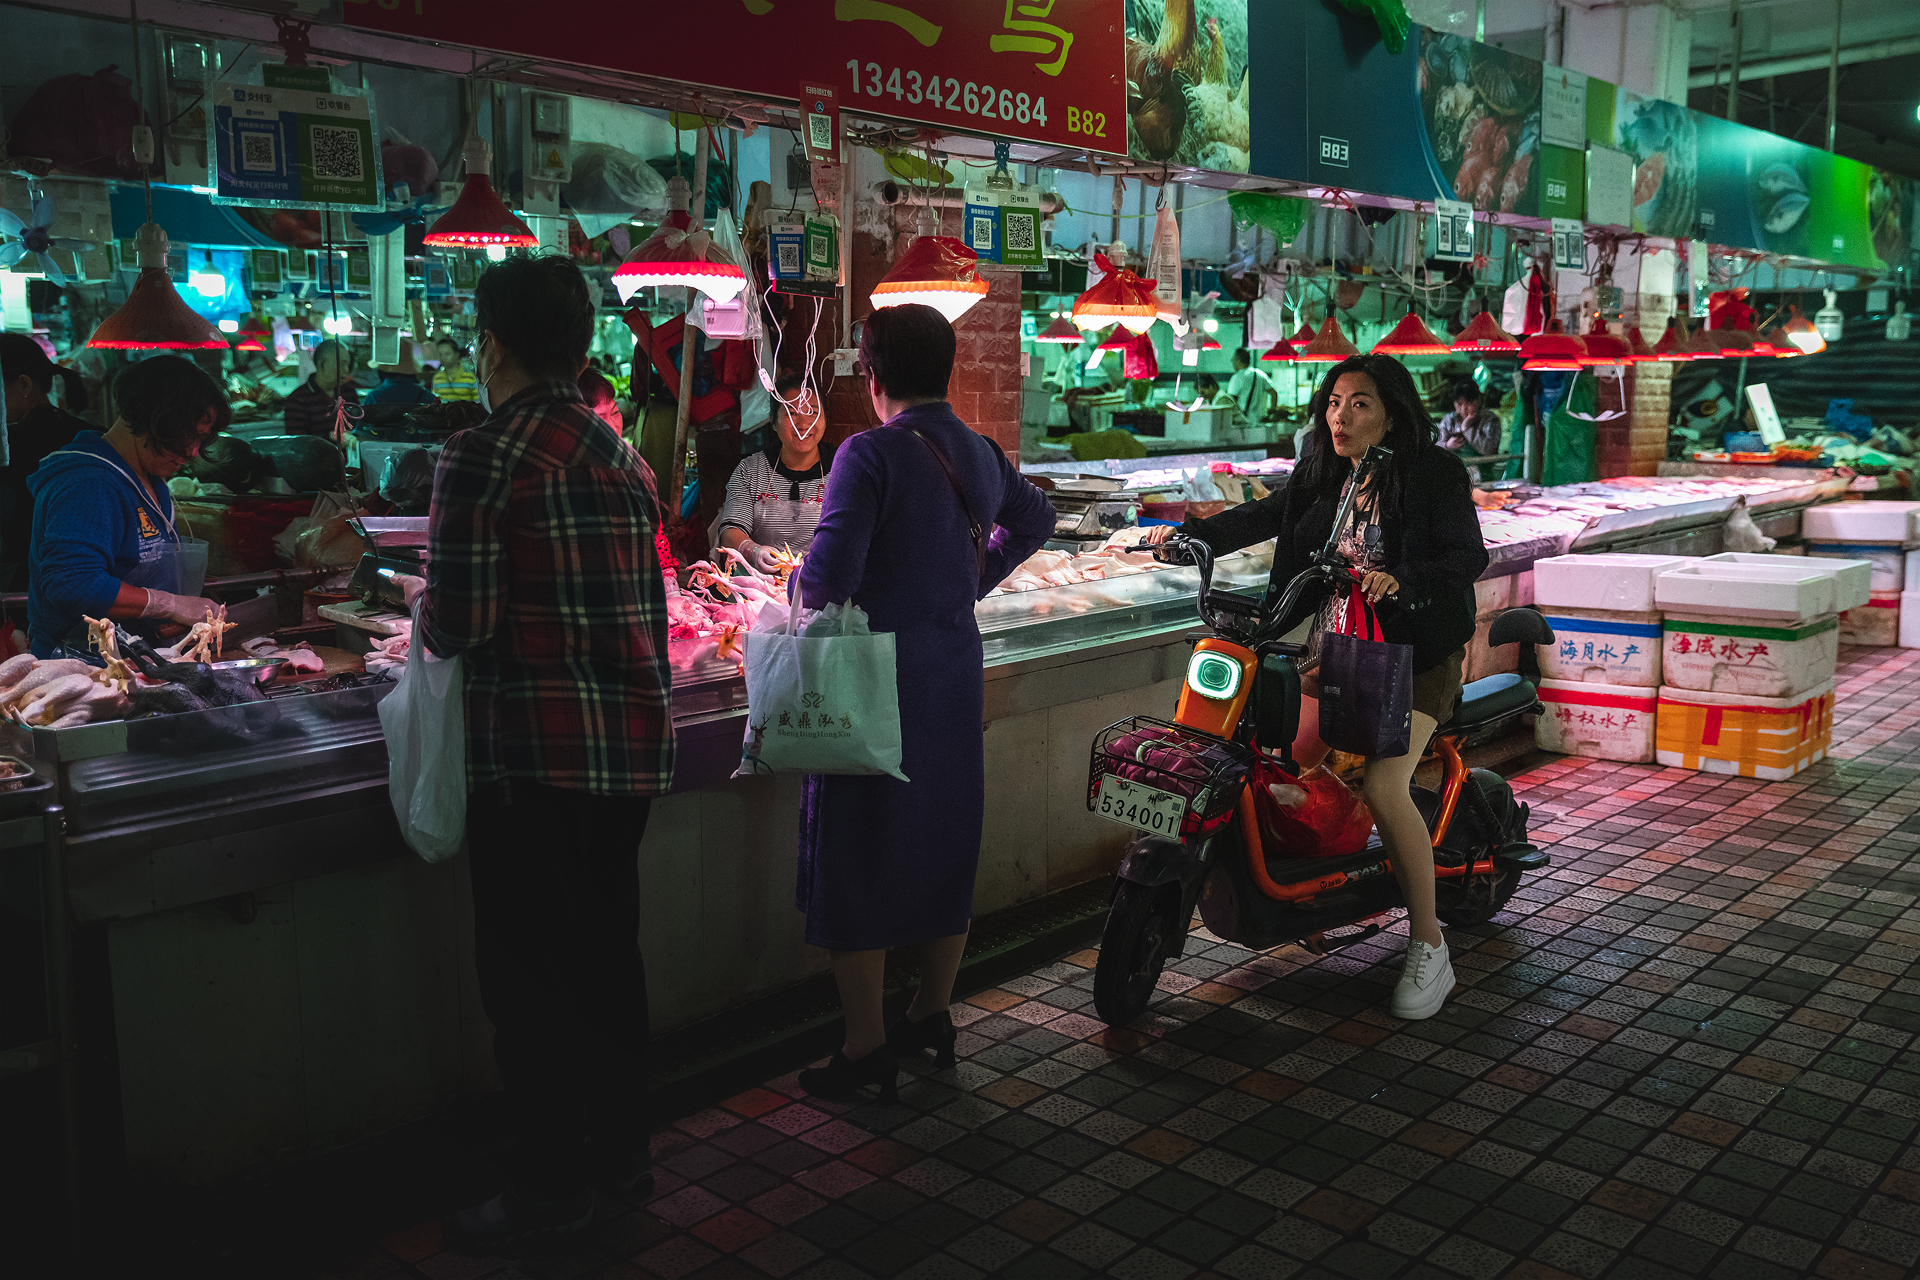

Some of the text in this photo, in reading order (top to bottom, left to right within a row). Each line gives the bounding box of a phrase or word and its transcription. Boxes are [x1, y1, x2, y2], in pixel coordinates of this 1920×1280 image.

[247, 92, 272, 103] 支付宝
[846, 58, 1048, 127] 13434262684
[1067, 106, 1107, 138] B82
[1322, 142, 1349, 161] B83
[1547, 183, 1567, 198] B84
[1559, 640, 1641, 665] 海月水产
[777, 728, 851, 739] ShengDingHongXiu
[1101, 791, 1175, 833] 534001
